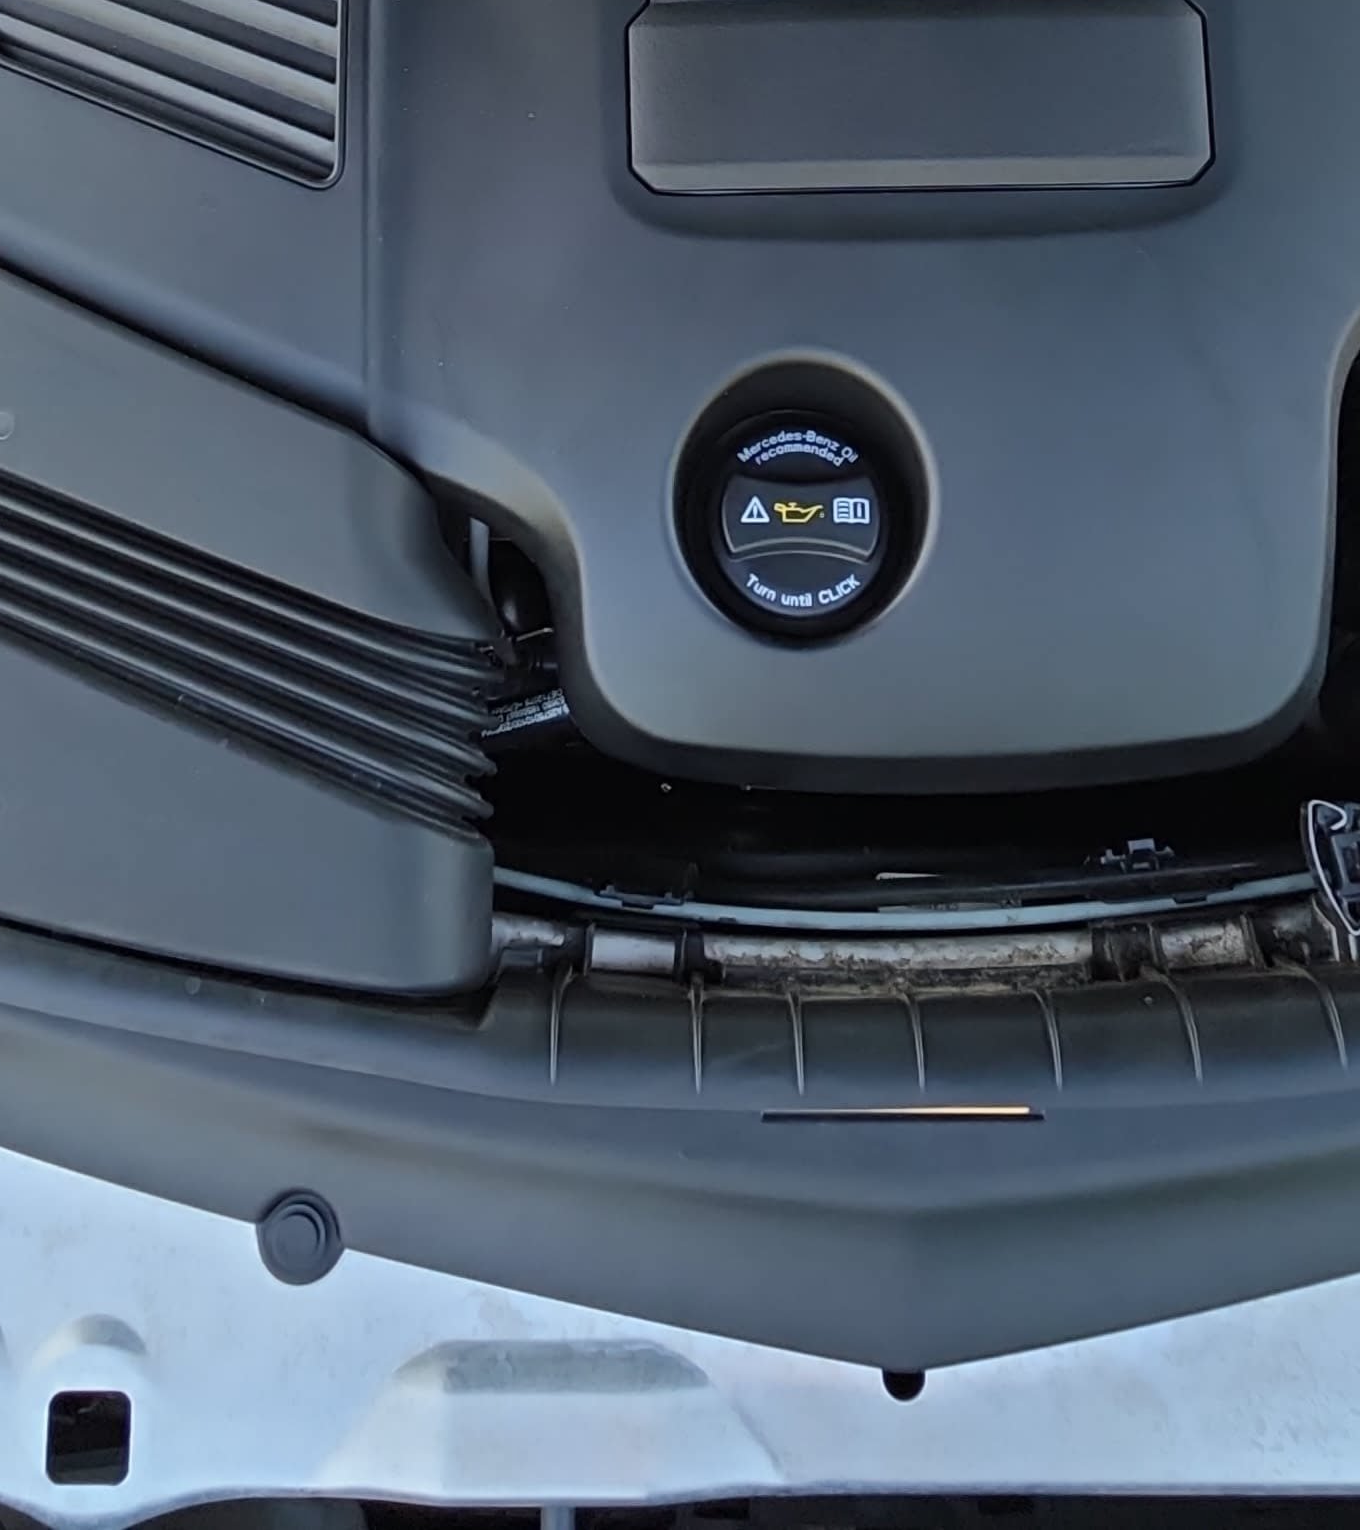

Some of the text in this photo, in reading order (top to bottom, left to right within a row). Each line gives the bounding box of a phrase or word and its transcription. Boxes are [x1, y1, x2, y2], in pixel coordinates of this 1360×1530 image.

[737, 430, 859, 463] Mercedes-Benz Oil
[755, 443, 845, 467] recommended
[746, 573, 861, 607] Turn until CLICK
